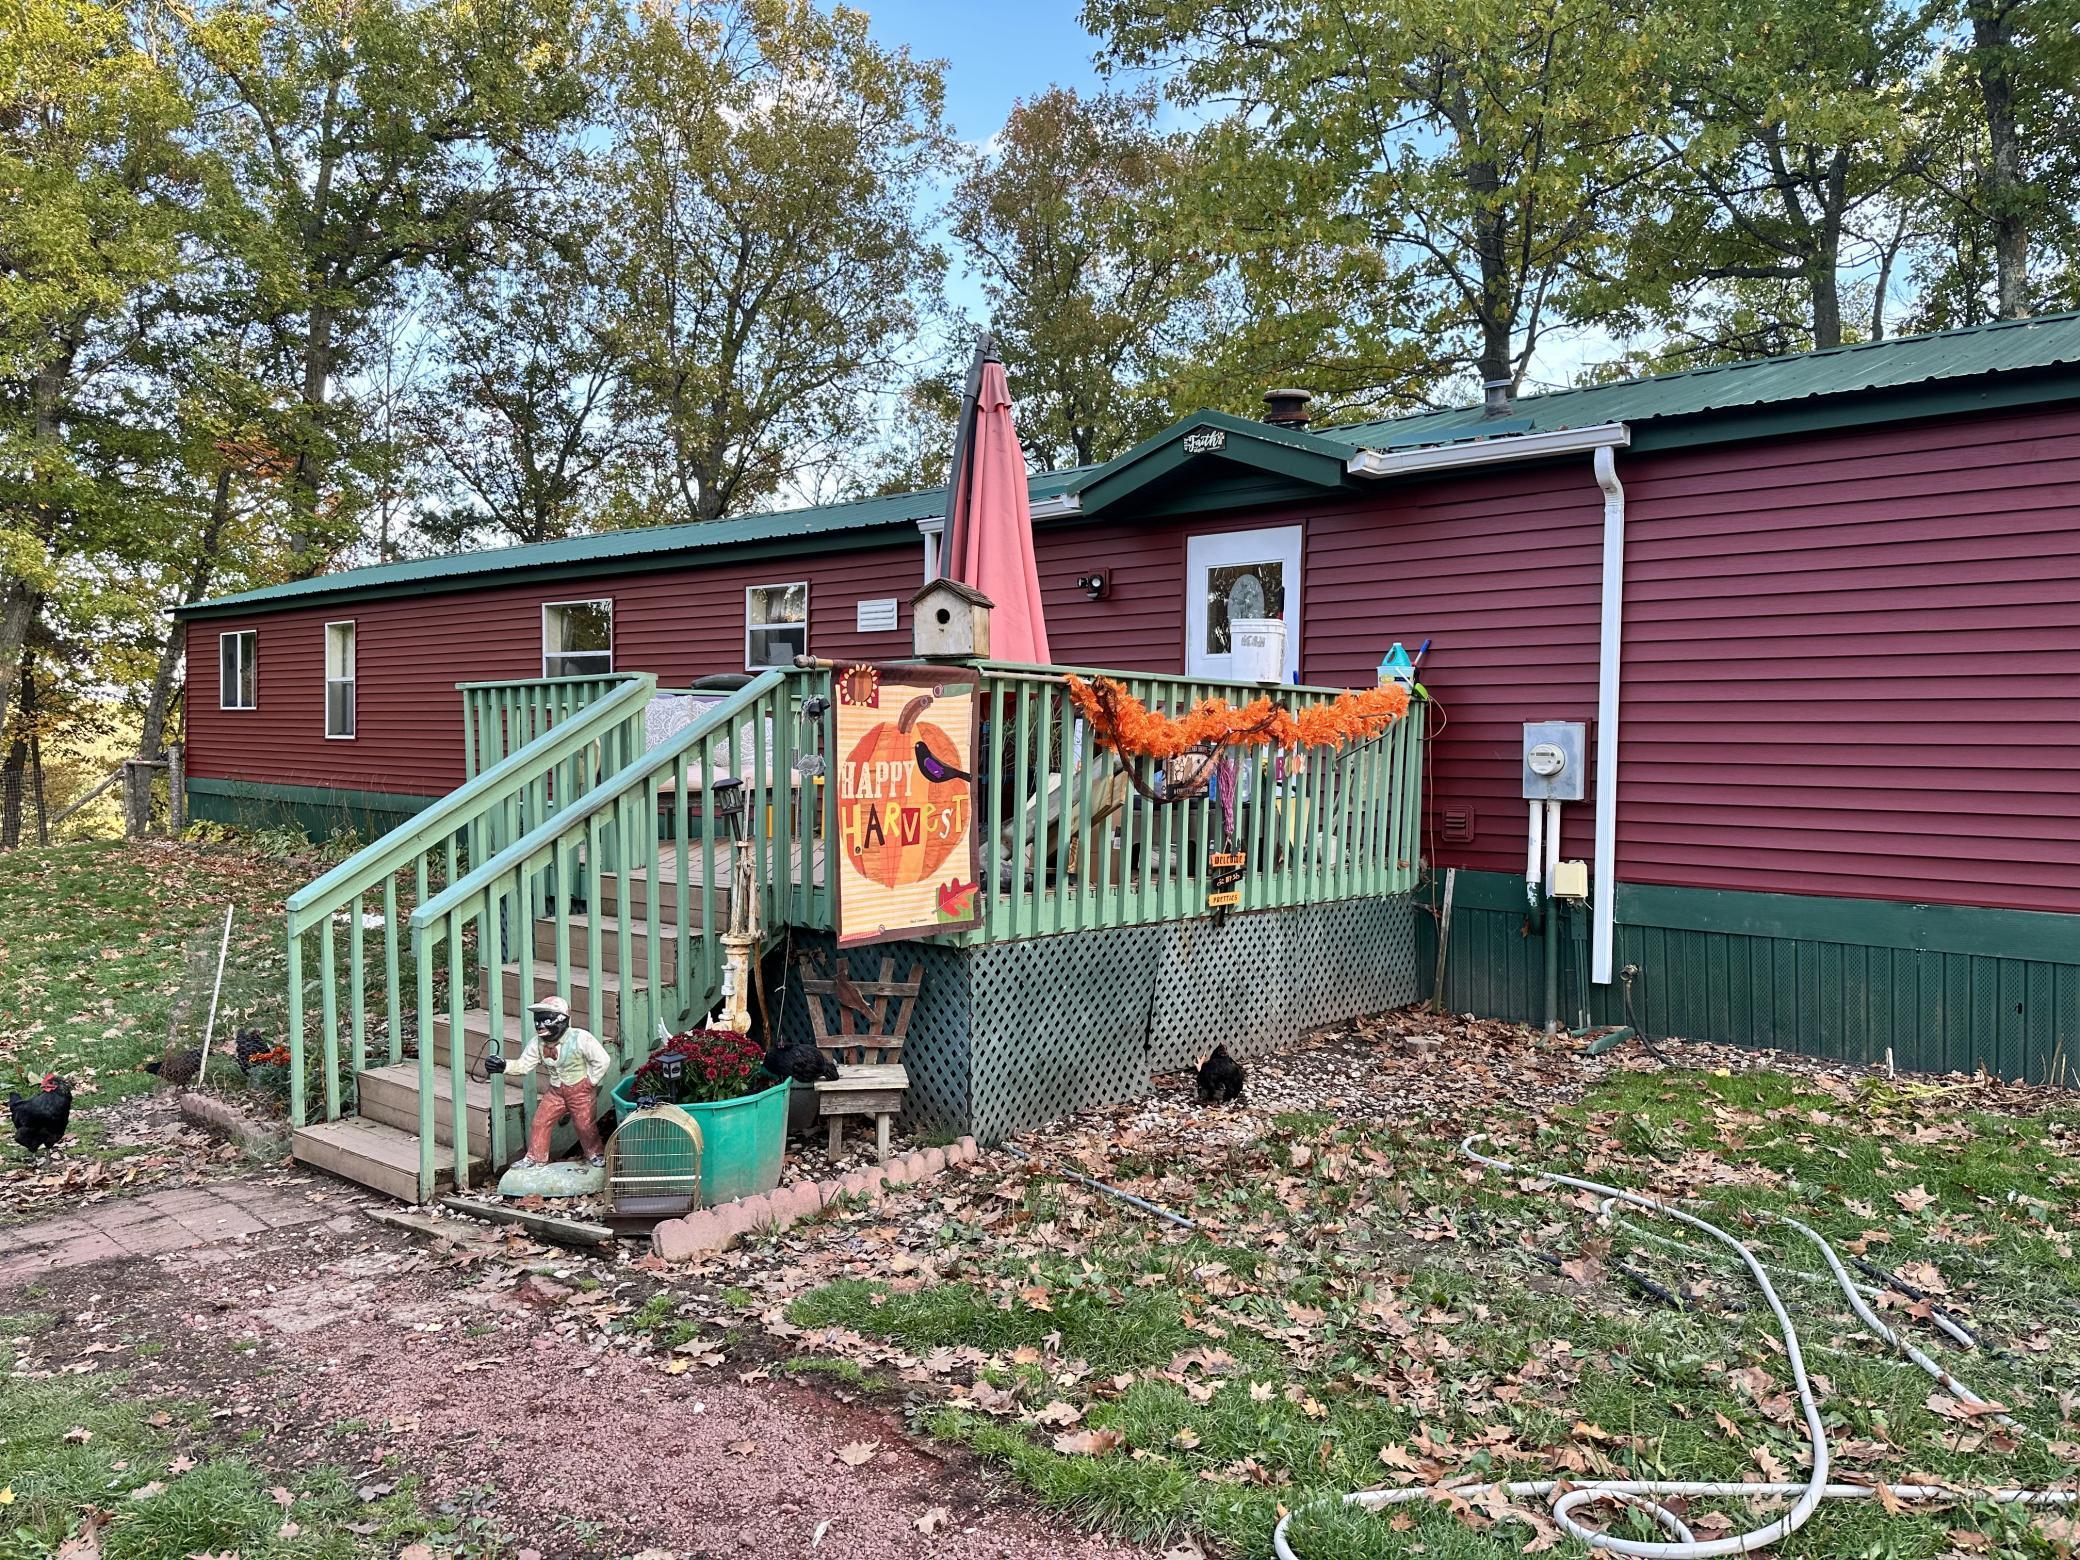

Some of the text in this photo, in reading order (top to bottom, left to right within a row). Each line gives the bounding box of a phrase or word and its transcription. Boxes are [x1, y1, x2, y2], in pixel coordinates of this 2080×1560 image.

[1188, 430, 1219, 453] Faith
[839, 761, 915, 799] HAPPY
[1214, 855, 1243, 865] WELCOME
[1213, 894, 1238, 903] PRETTIES
